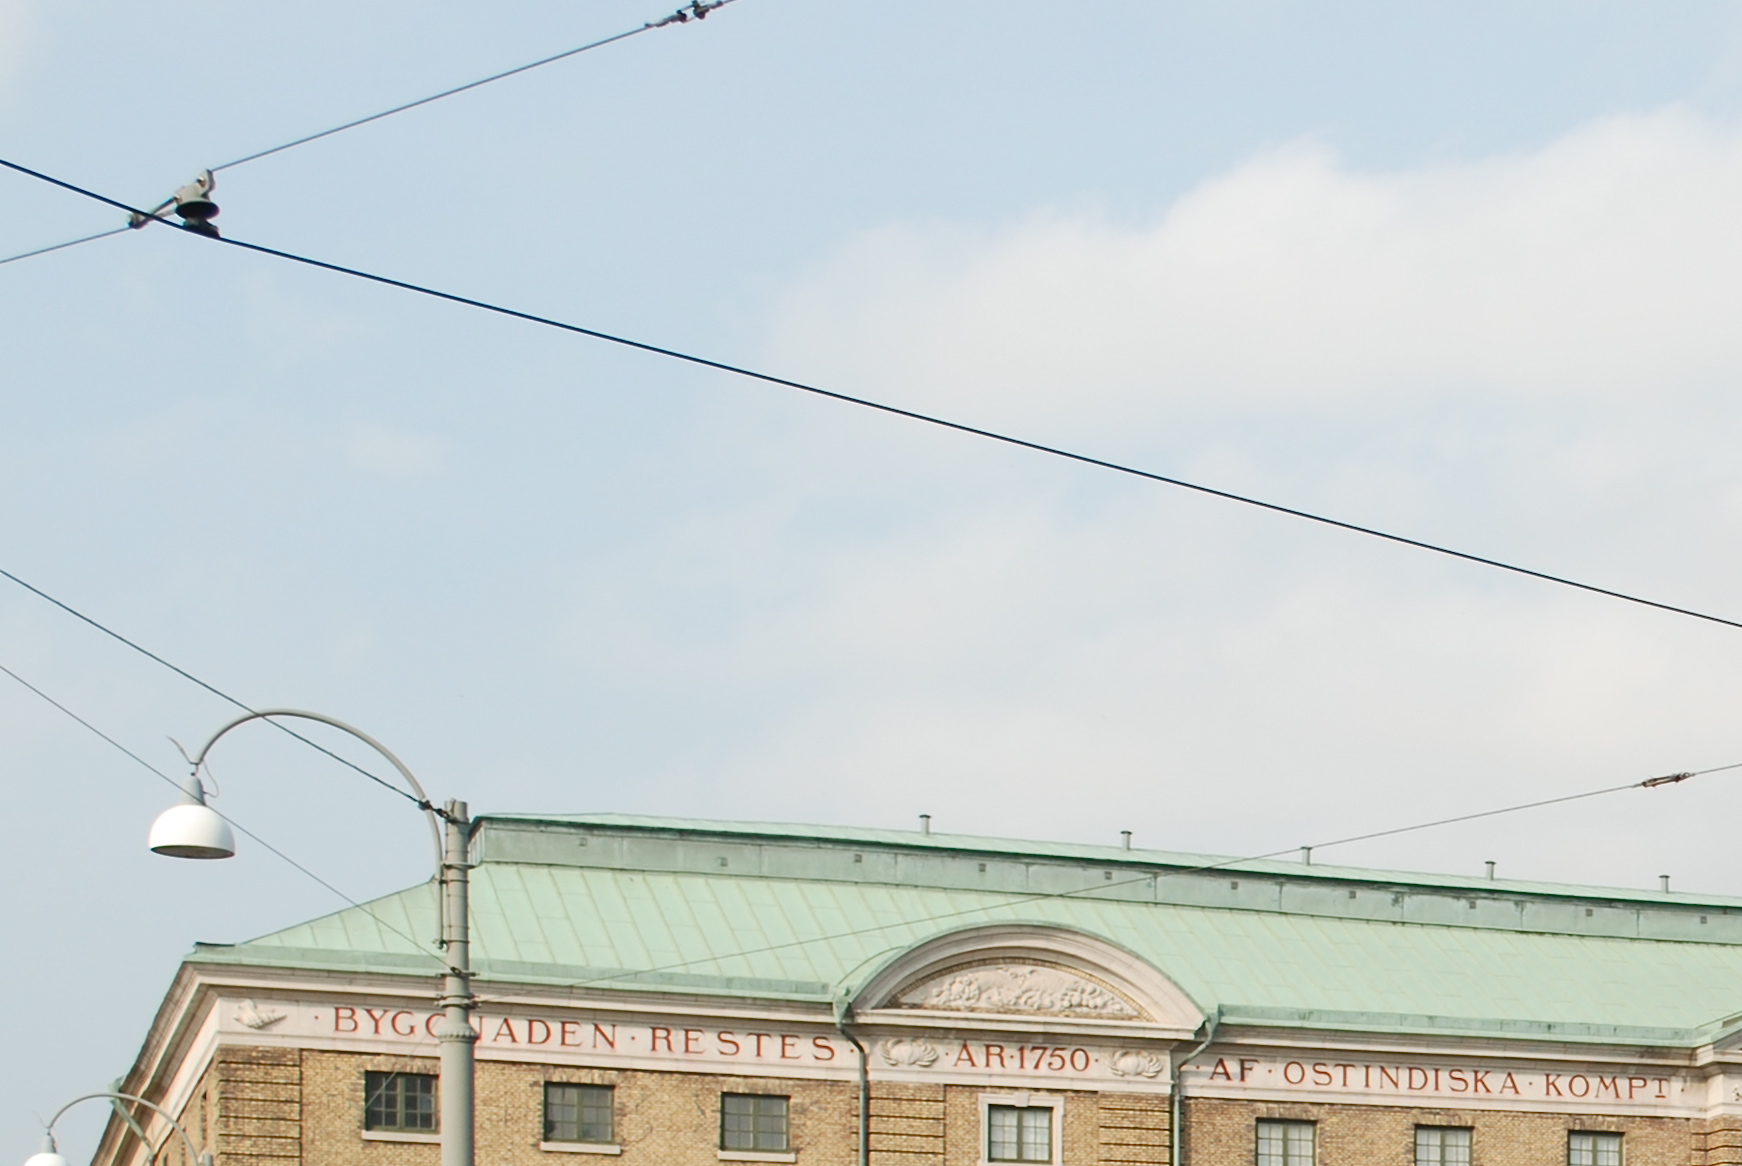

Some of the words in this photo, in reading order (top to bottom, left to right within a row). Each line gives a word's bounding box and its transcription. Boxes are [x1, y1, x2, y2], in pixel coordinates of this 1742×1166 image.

[650, 1026, 836, 1061] RESTES
[1017, 1045, 1091, 1072] 1750
[1209, 1057, 1260, 1083] AF
[1283, 1060, 1521, 1096] OSTINDISKA
